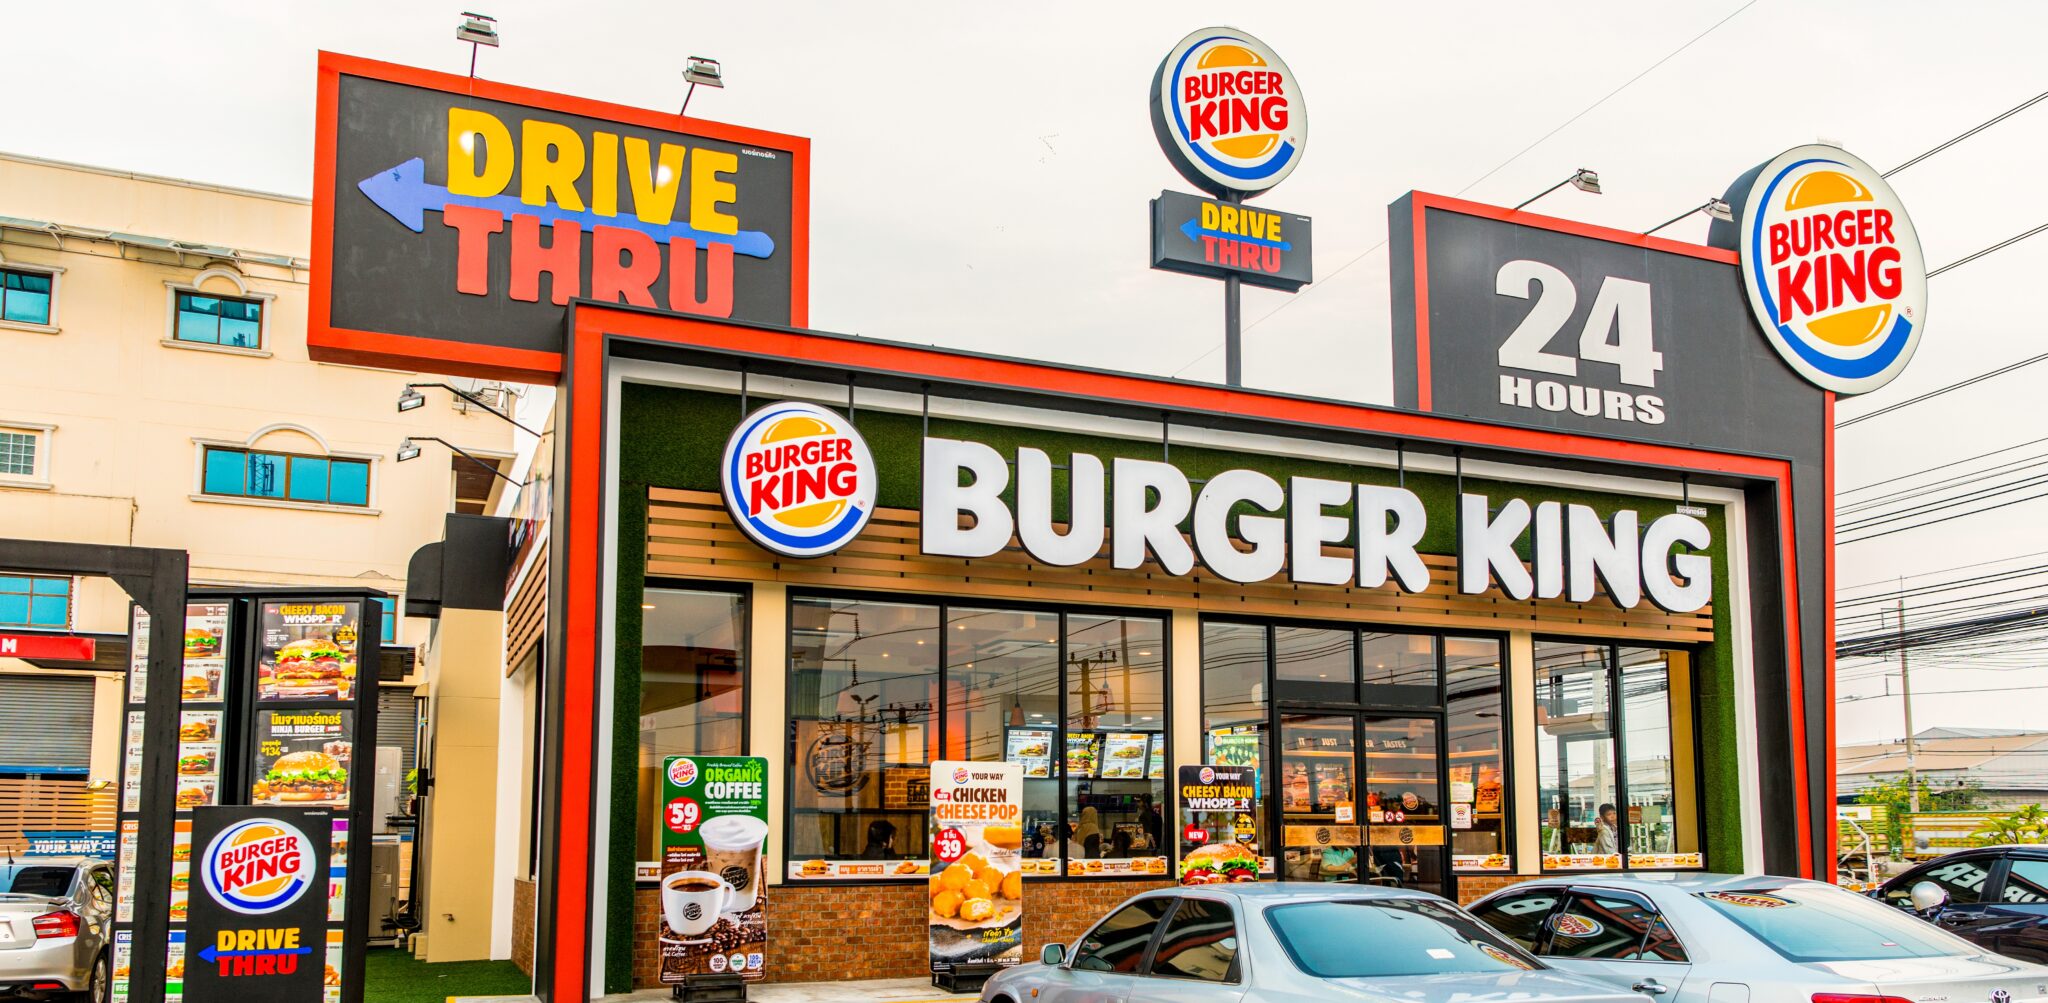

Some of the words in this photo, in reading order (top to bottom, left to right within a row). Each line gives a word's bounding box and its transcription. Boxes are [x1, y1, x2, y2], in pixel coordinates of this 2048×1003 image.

[1185, 71, 1283, 103] BURGER
[1190, 96, 1288, 141] KING
[447, 107, 738, 235] DRIVE
[1202, 201, 1281, 242] DRIVE
[1769, 209, 1895, 266] BURGER
[443, 204, 734, 318] THRU
[1201, 235, 1281, 273] THRU
[1778, 246, 1902, 324] KING
[1496, 260, 1663, 388] 24
[1500, 375, 1665, 425] HOURS
[746, 438, 853, 480] BURGER
[750, 462, 857, 516] KING
[920, 436, 1430, 593] BURGER
[1457, 493, 1712, 613] KING
[280, 605, 313, 615] CHEESY
[315, 605, 346, 615] BACON
[271, 726, 293, 734] NINJA
[294, 726, 325, 734] BURGER
[1321, 738, 1337, 746] JUST
[1382, 740, 1406, 748] TASTES
[673, 769, 695, 780] KING
[704, 782, 762, 799] COFFEE
[705, 768, 762, 782] ORGANIC
[953, 788, 1006, 802] CHICKEN
[1183, 786, 1220, 798] CHEESY
[1223, 786, 1253, 798] BACON
[936, 804, 986, 819] CHEESE
[989, 804, 1018, 820] POP
[34, 840, 67, 853] YOUR
[70, 840, 99, 853] WAY
[1188, 831, 1203, 839] NEW
[220, 837, 298, 870] BURGER
[222, 852, 300, 893] KING
[217, 928, 300, 952] DRIVE
[216, 954, 298, 977] THRU
